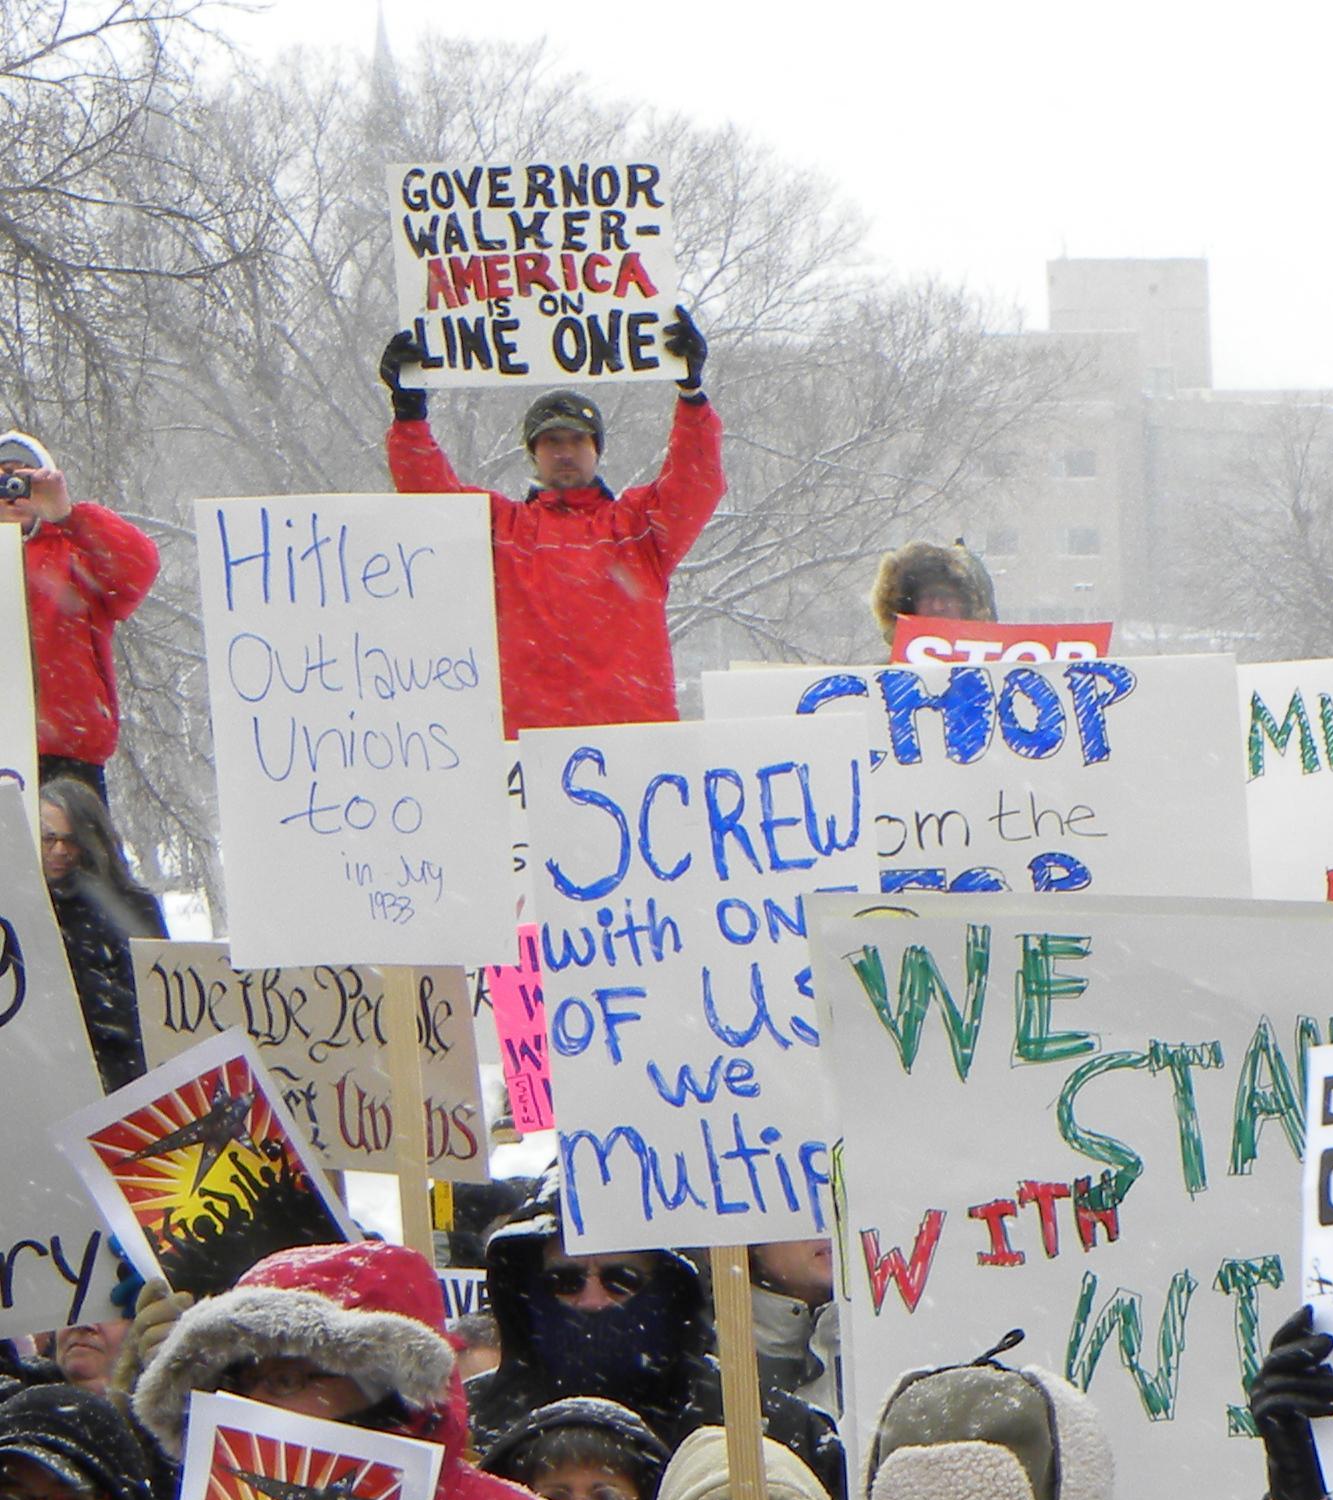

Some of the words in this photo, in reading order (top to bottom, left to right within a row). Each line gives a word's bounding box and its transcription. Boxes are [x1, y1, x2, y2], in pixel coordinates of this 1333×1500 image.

[402, 163, 664, 212] GOVERNOR
[403, 209, 661, 258] WALKER-
[426, 252, 660, 310] AMERICA
[486, 297, 511, 318] IS
[539, 292, 583, 316] ON
[415, 315, 529, 375] LINE
[552, 309, 660, 376] ONE
[216, 509, 437, 611] Hitler
[229, 632, 480, 703] Outlawed
[252, 711, 459, 781] Unions
[280, 781, 422, 833] too
[545, 747, 861, 901] SCREW
[987, 790, 1108, 844] the
[341, 851, 372, 886] in
[148, 955, 228, 1033] We
[309, 964, 453, 1063] Pele
[550, 986, 647, 1066] OF
[840, 922, 1101, 1084] WE
[332, 1067, 478, 1164] Unns
[0, 1228, 101, 1325] ry
[857, 1169, 1122, 1316] WITH
